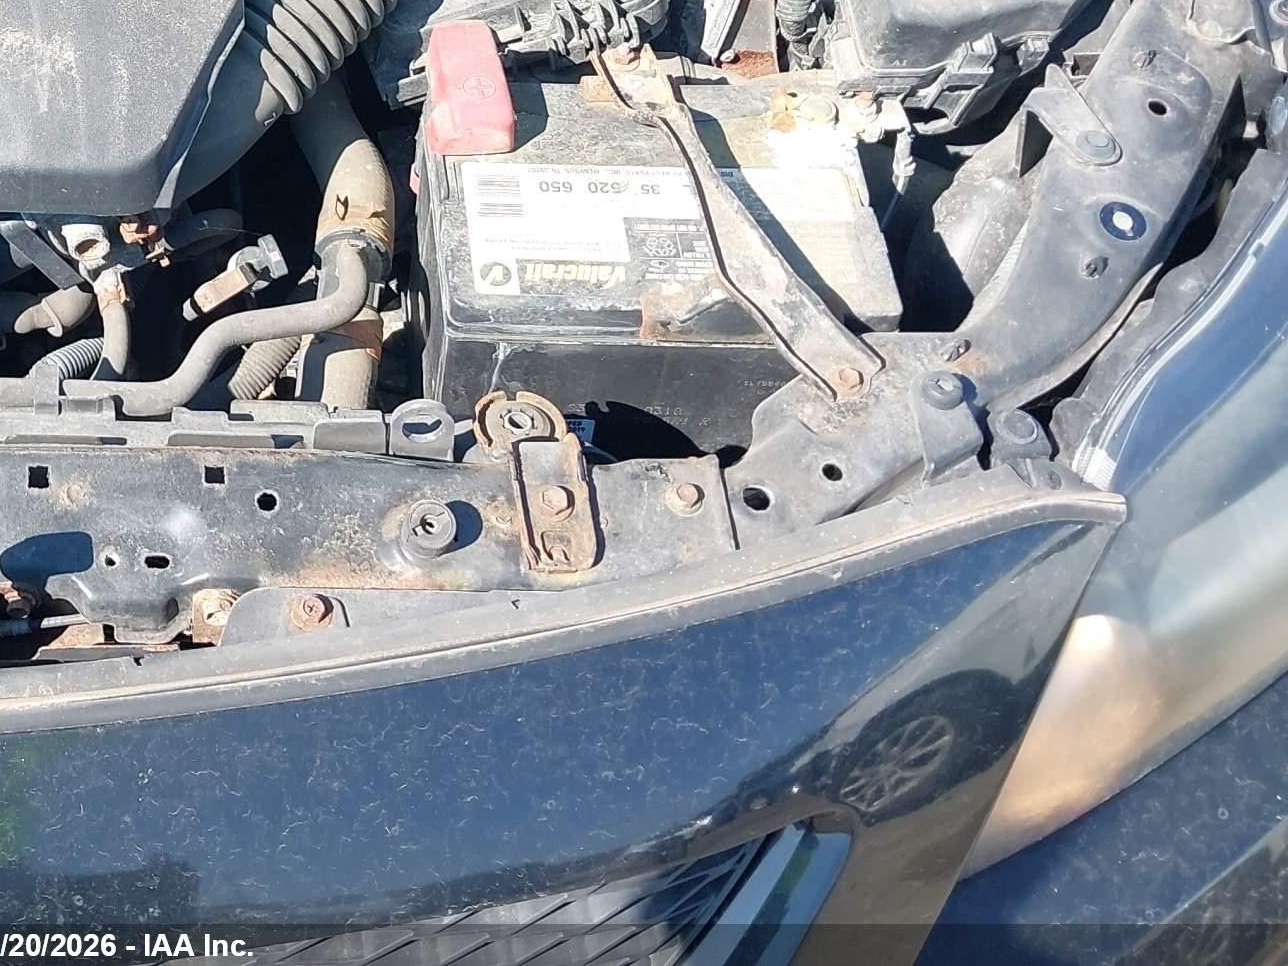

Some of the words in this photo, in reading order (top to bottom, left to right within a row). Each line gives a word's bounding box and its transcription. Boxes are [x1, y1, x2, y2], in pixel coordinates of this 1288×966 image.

[538, 180, 573, 194] 650
[587, 180, 622, 195] 520
[640, 183, 661, 195] 35
[524, 262, 627, 290] Valucraft
